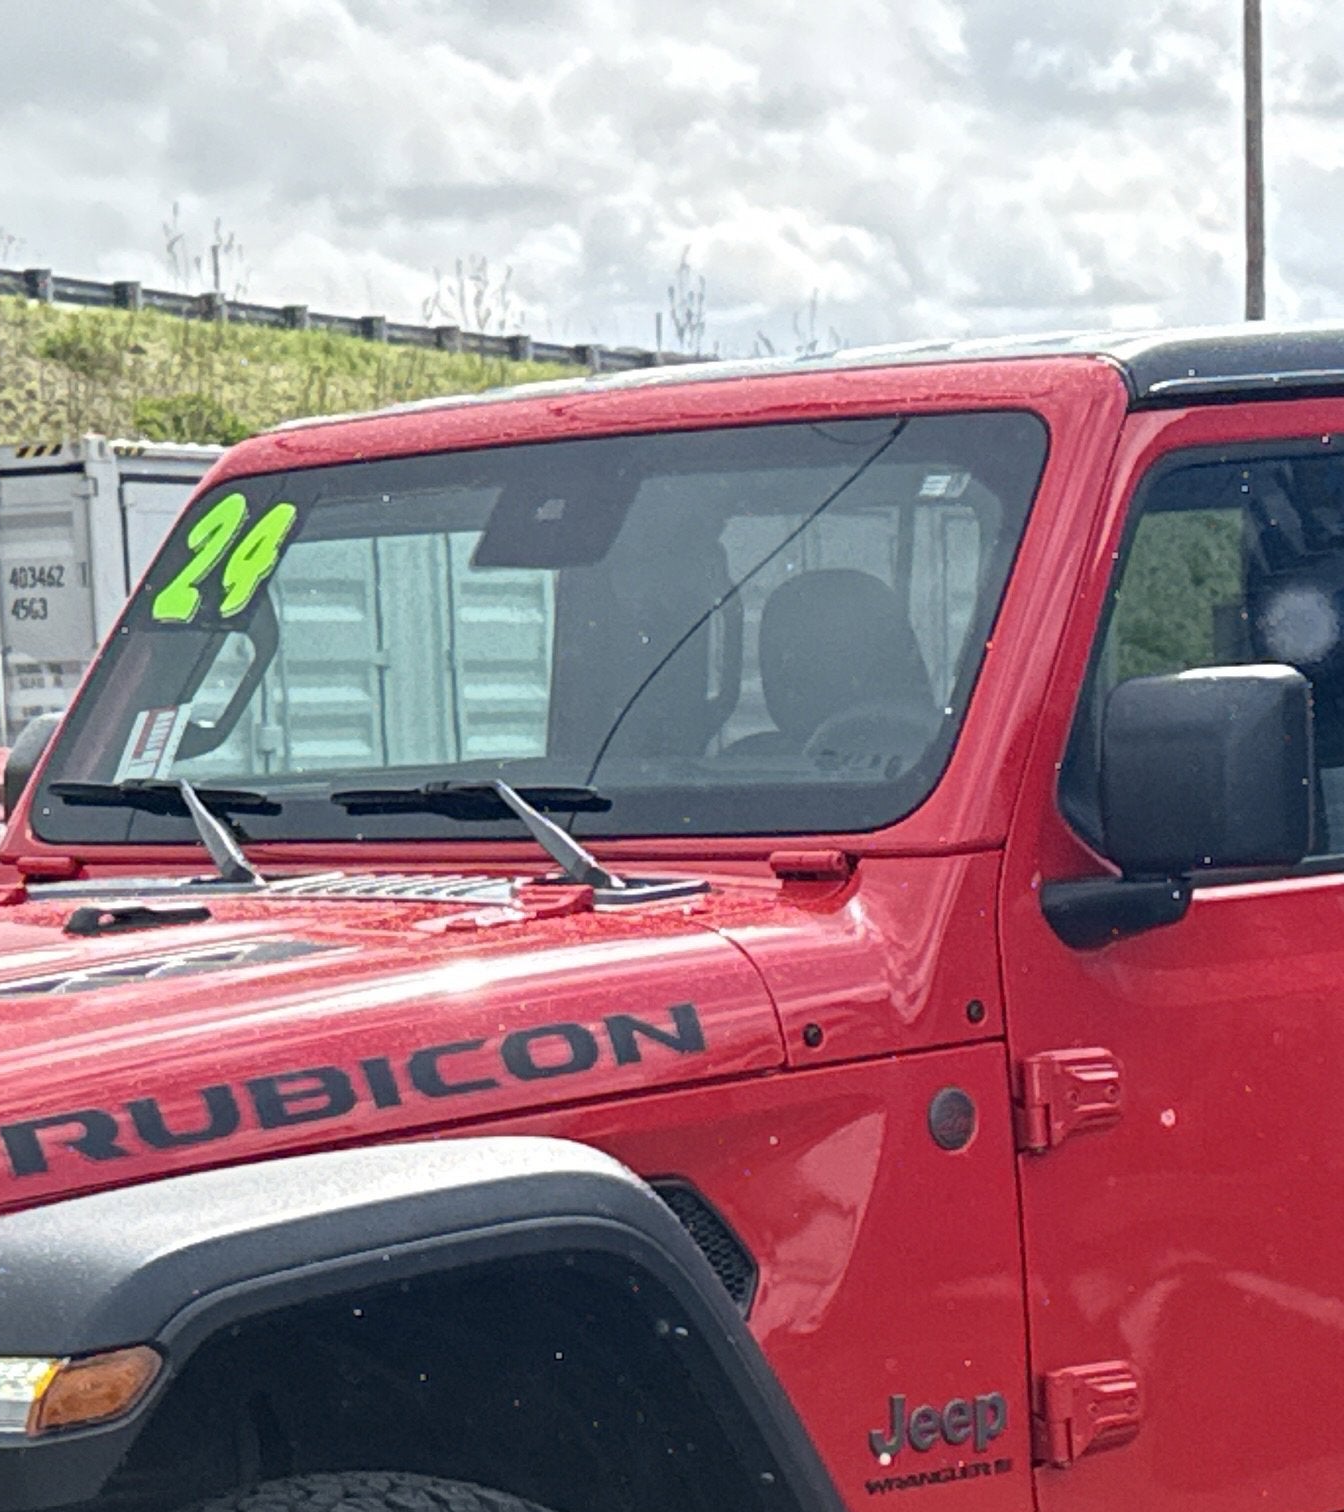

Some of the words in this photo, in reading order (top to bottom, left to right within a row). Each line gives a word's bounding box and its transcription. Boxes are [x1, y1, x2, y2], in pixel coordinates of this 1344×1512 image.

[9, 564, 66, 590] 403462
[153, 493, 297, 623] 24
[868, 1391, 1007, 1463] Jeep
[864, 1460, 992, 1495] WRANGLER
